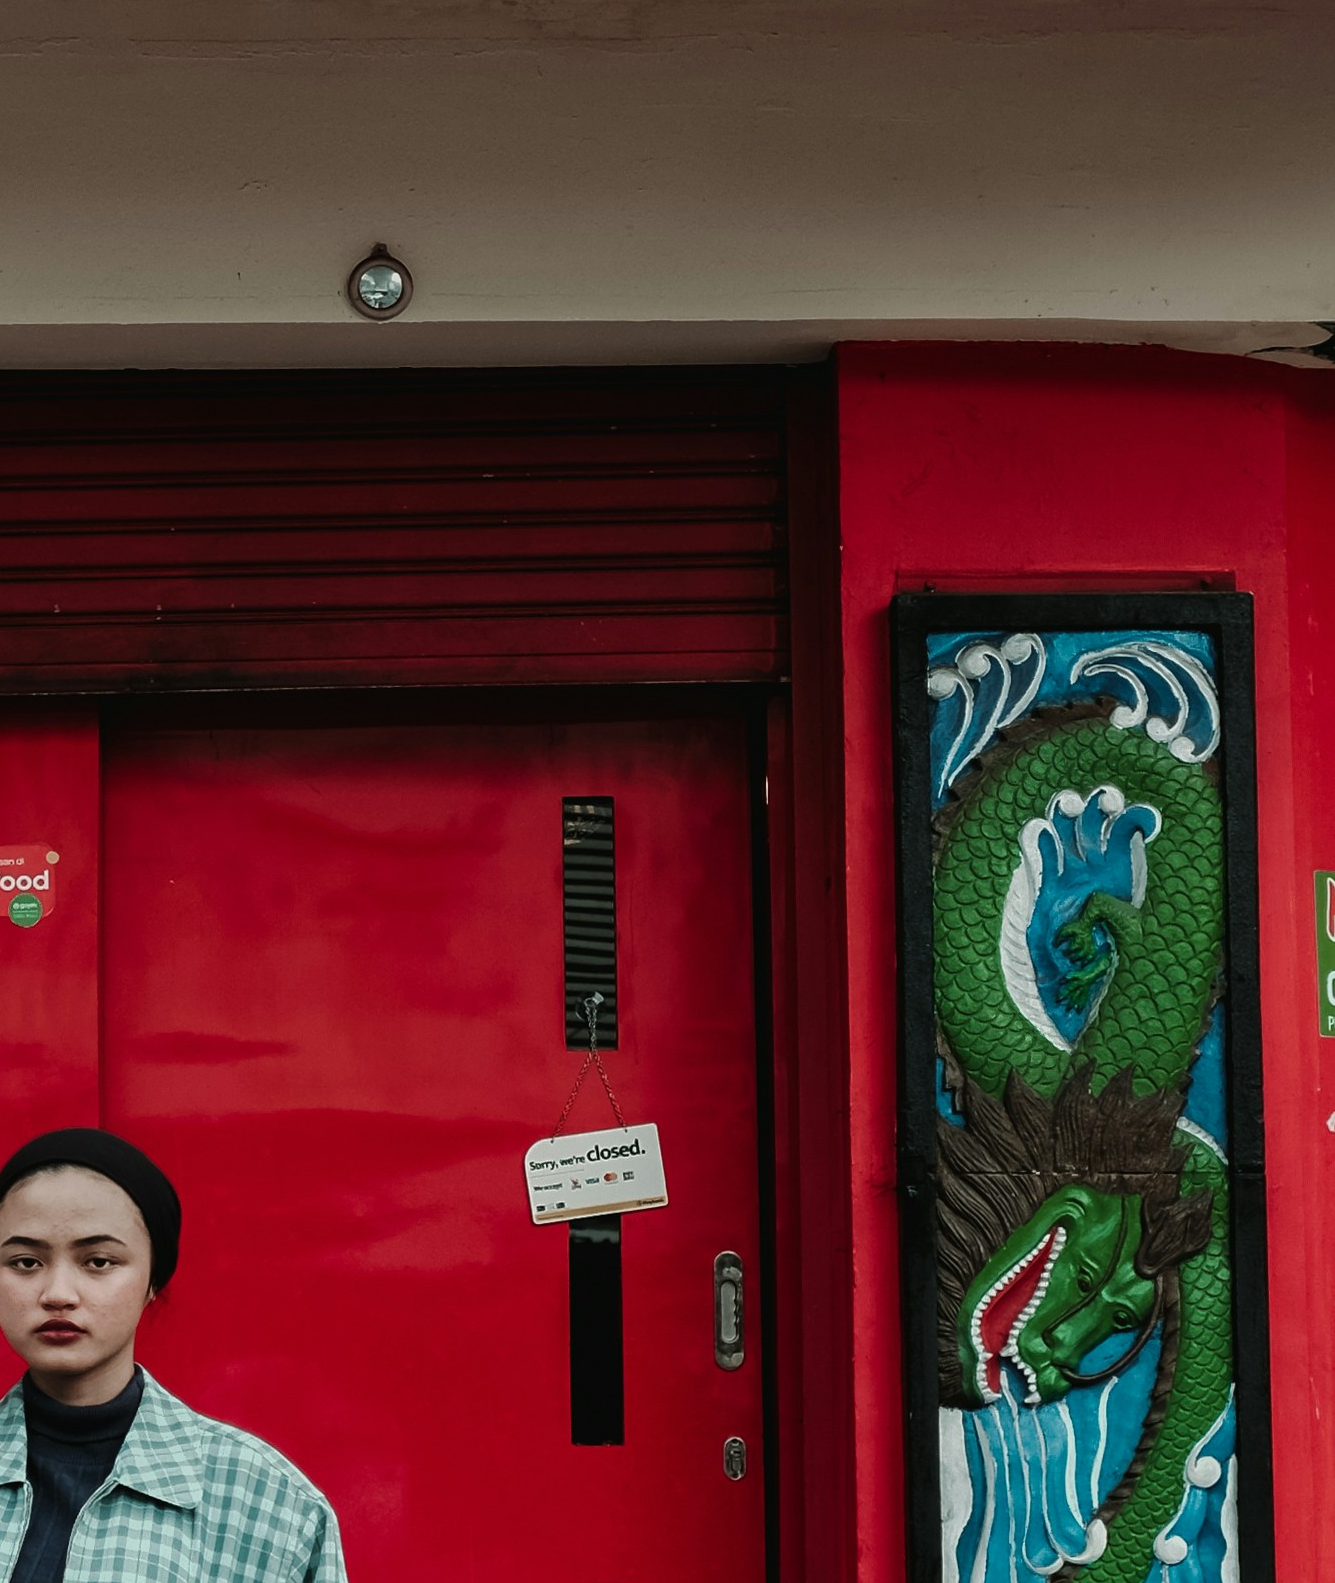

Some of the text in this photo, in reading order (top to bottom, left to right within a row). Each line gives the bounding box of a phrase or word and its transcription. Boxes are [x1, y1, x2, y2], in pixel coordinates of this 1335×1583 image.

[529, 1138, 646, 1171] Sorry, we're closed.
